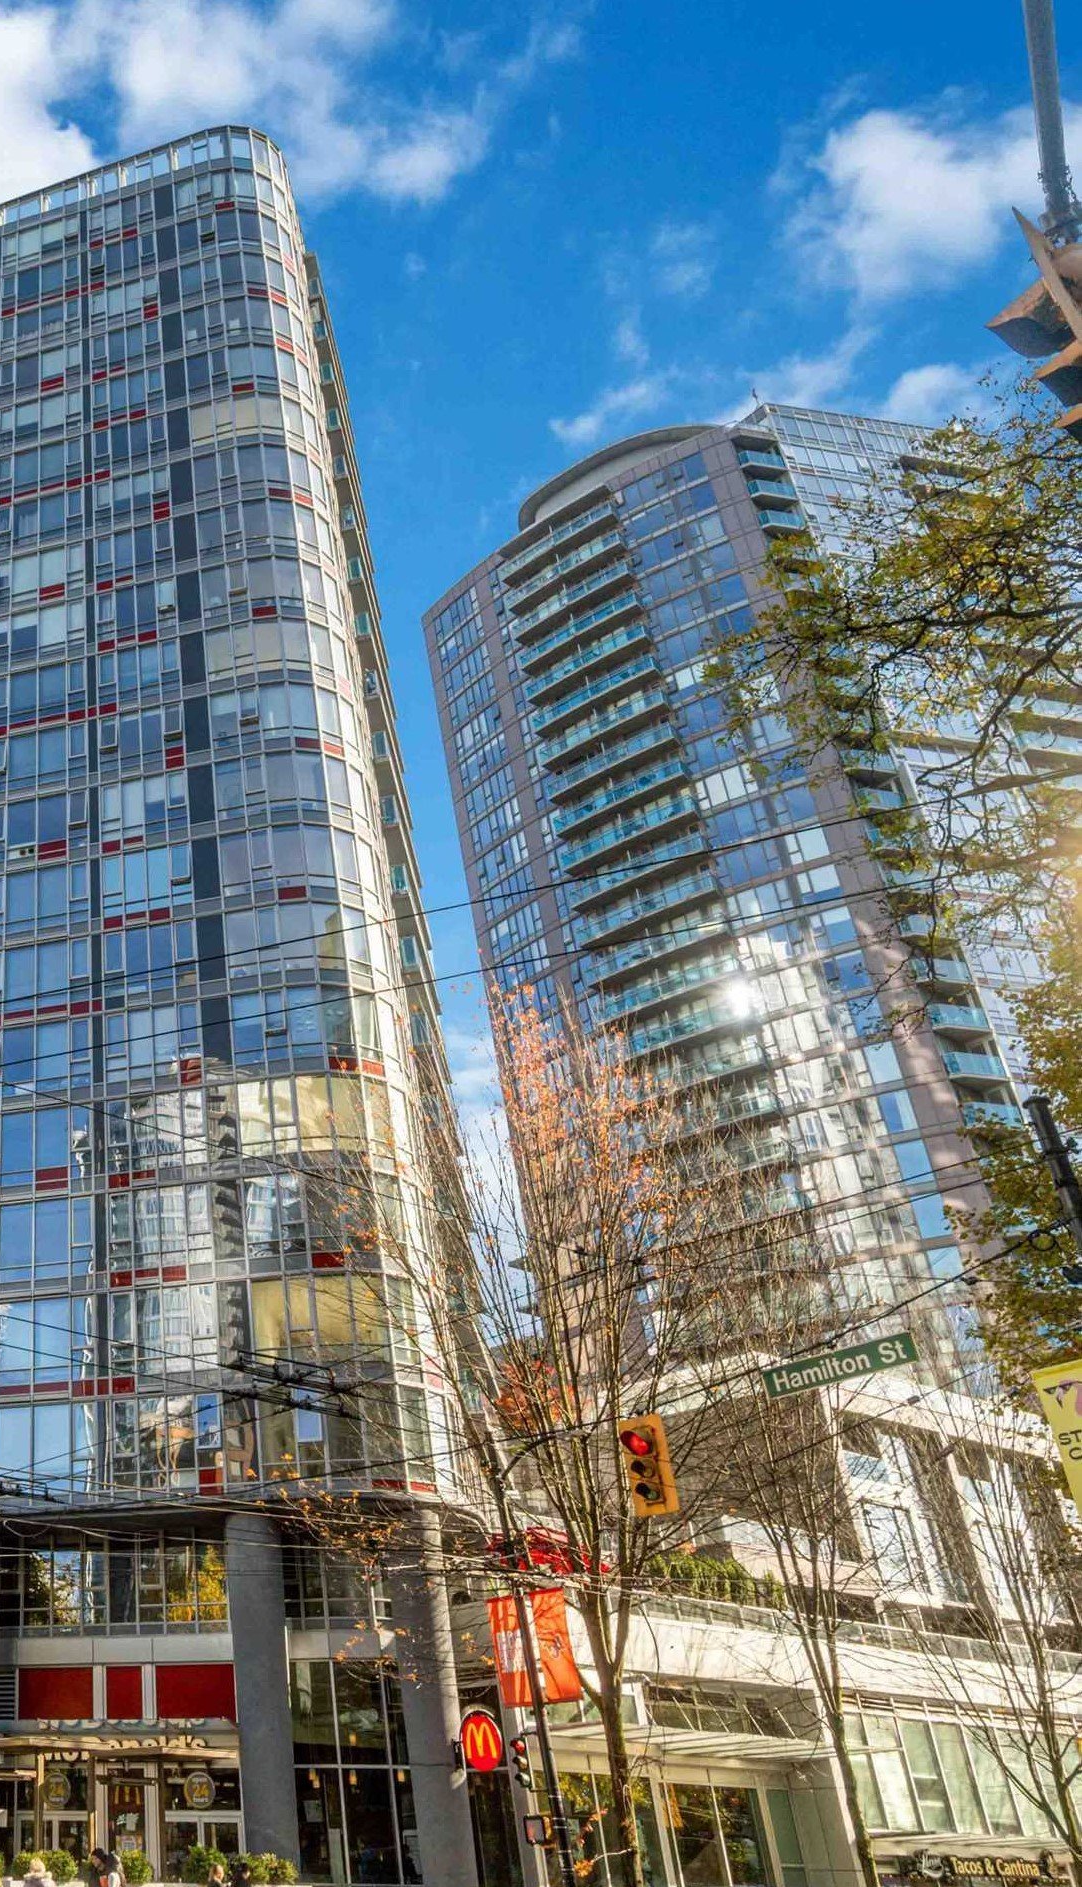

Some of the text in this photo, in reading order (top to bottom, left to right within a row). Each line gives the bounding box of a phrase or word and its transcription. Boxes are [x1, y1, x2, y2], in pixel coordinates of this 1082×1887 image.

[773, 1340, 907, 1392] Hamilton St
[950, 1857, 984, 1875] Tacos
[984, 1857, 996, 1875] &
[996, 1858, 1040, 1876] Cantina
